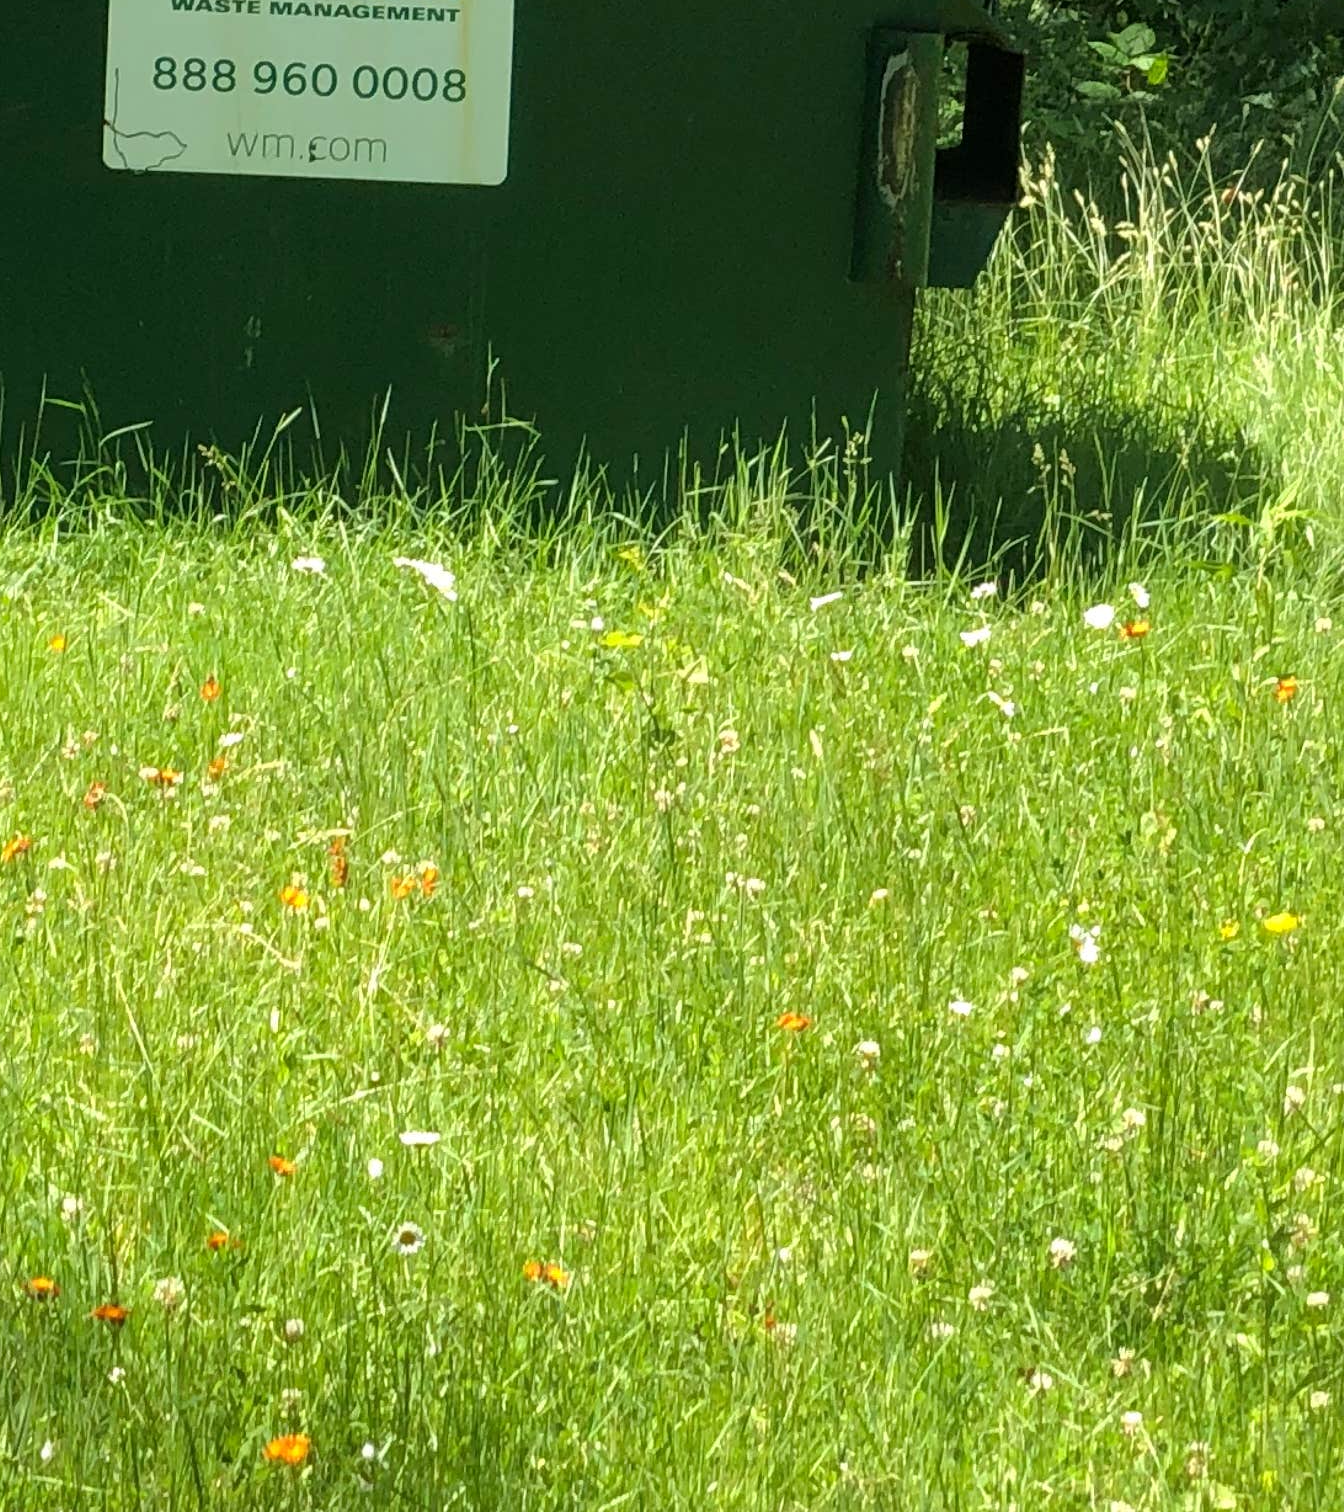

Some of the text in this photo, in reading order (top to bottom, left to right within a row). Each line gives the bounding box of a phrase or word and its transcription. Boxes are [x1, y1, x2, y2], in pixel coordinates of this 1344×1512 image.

[269, 1, 461, 22] MANAGEMENT
[152, 56, 467, 103] 888 960 0008
[227, 132, 387, 163] wm.com
